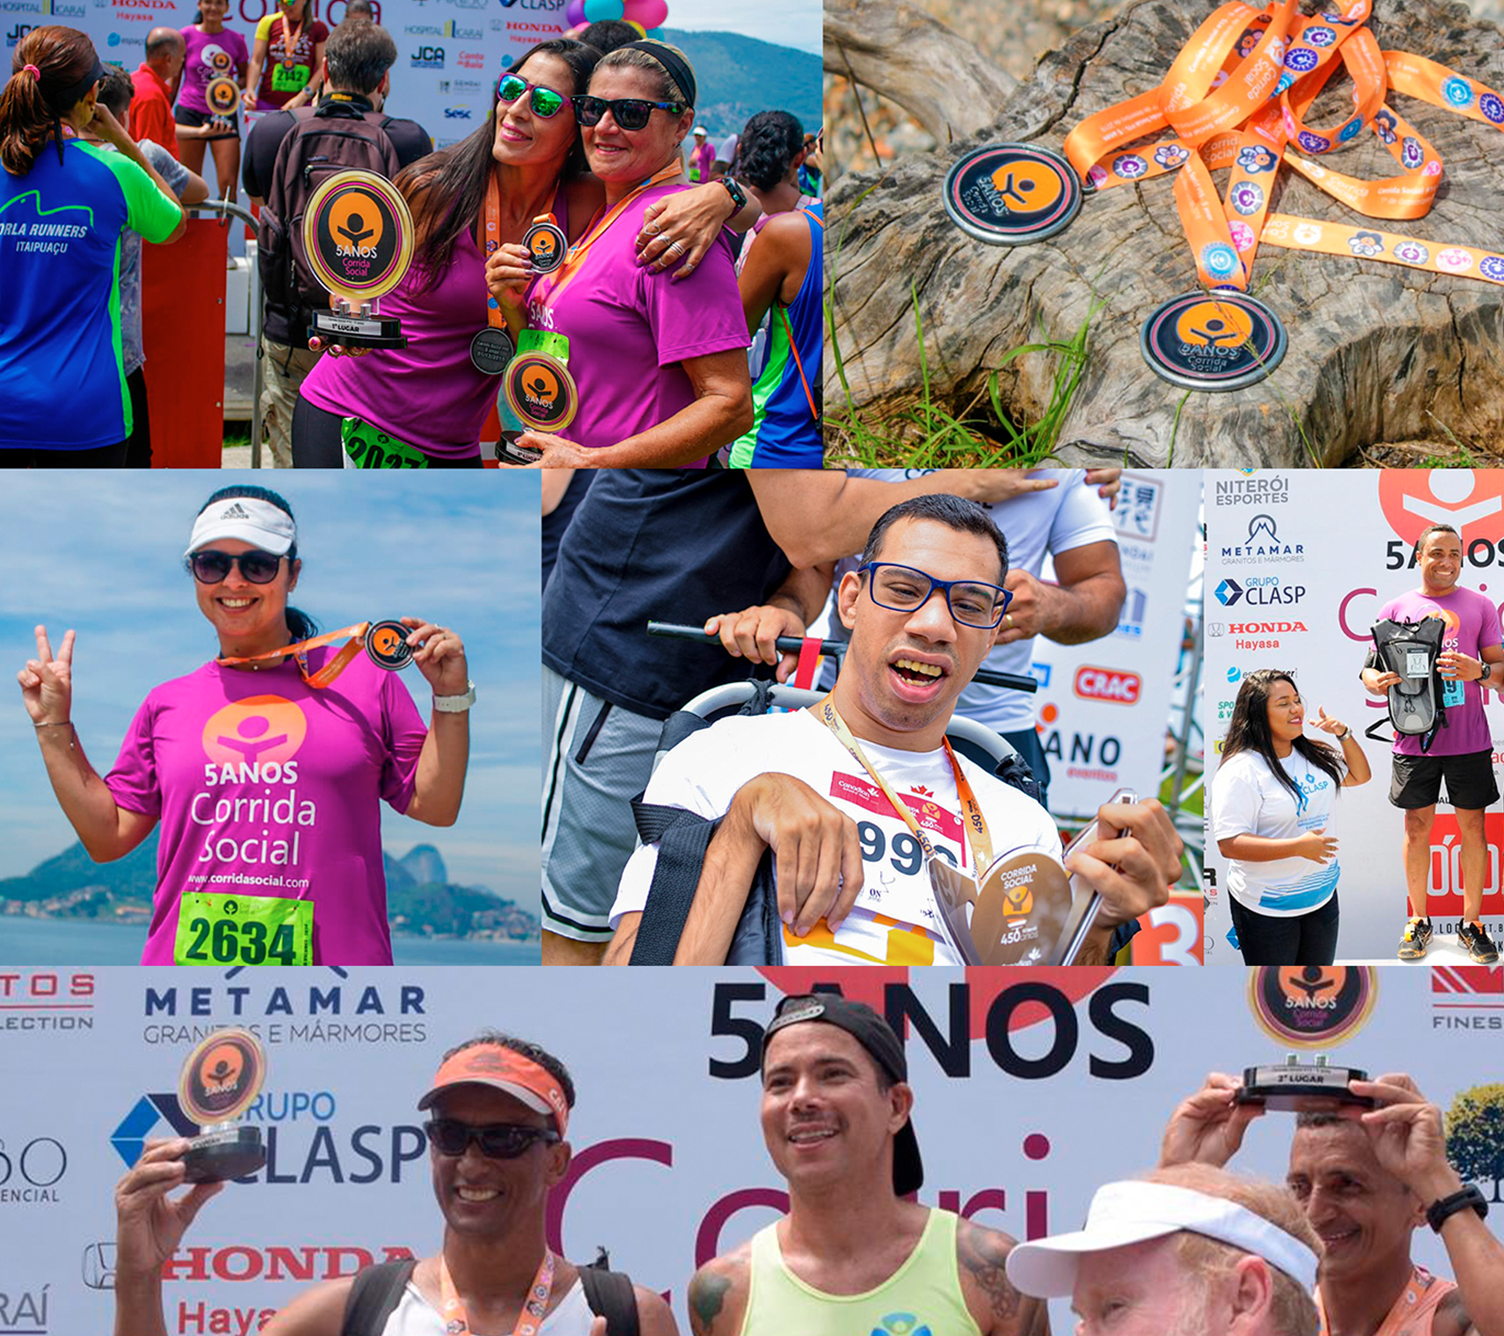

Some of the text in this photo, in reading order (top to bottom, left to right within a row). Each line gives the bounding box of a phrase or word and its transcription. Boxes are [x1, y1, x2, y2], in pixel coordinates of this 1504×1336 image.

[506, 21, 563, 33] HONDA
[411, 46, 445, 61] JCA
[444, 105, 472, 120] Sesc
[29, 224, 88, 238] RUNNERS
[16, 241, 68, 255] ITAIPUAÇU
[342, 257, 371, 269] Corrida
[345, 266, 368, 276] Social
[1181, 343, 1240, 358] 5ANOS
[1188, 356, 1227, 367] Corrida
[1191, 363, 1222, 373] Social
[1216, 475, 1289, 494] NITERÓI
[1216, 492, 1289, 506] ESPORTES
[1221, 545, 1304, 557] METAMAR
[1221, 557, 1257, 565] GRANITOS
[1264, 555, 1305, 563] MÁRMORES
[1245, 576, 1279, 588] GRUPO
[1245, 586, 1306, 605] CLASP
[1228, 621, 1308, 634] HONDA
[1236, 639, 1280, 651] Hayasa
[1079, 671, 1139, 699] CRAC
[1218, 701, 1235, 710] SPO
[204, 761, 299, 787] 5ANOS
[1303, 780, 1329, 795] CLASP
[191, 788, 316, 826] Corrida
[198, 830, 300, 866] Social
[1000, 863, 1037, 882] CORRIDA
[188, 873, 310, 889] www.corridasocial.com
[1003, 875, 1034, 890] SOCIAL
[186, 916, 297, 966] 2634
[1000, 928, 1021, 945] 450
[144, 987, 426, 1016] METAMAR
[1285, 996, 1337, 1010] 5ANOS
[143, 1018, 427, 1043] GRANS E MÁRMORES
[708, 982, 1155, 1080] 5NOS
[1289, 1074, 1324, 1084] LUGAR
[238, 1092, 335, 1121] RUPO
[1, 1189, 60, 1202] ENCIAL
